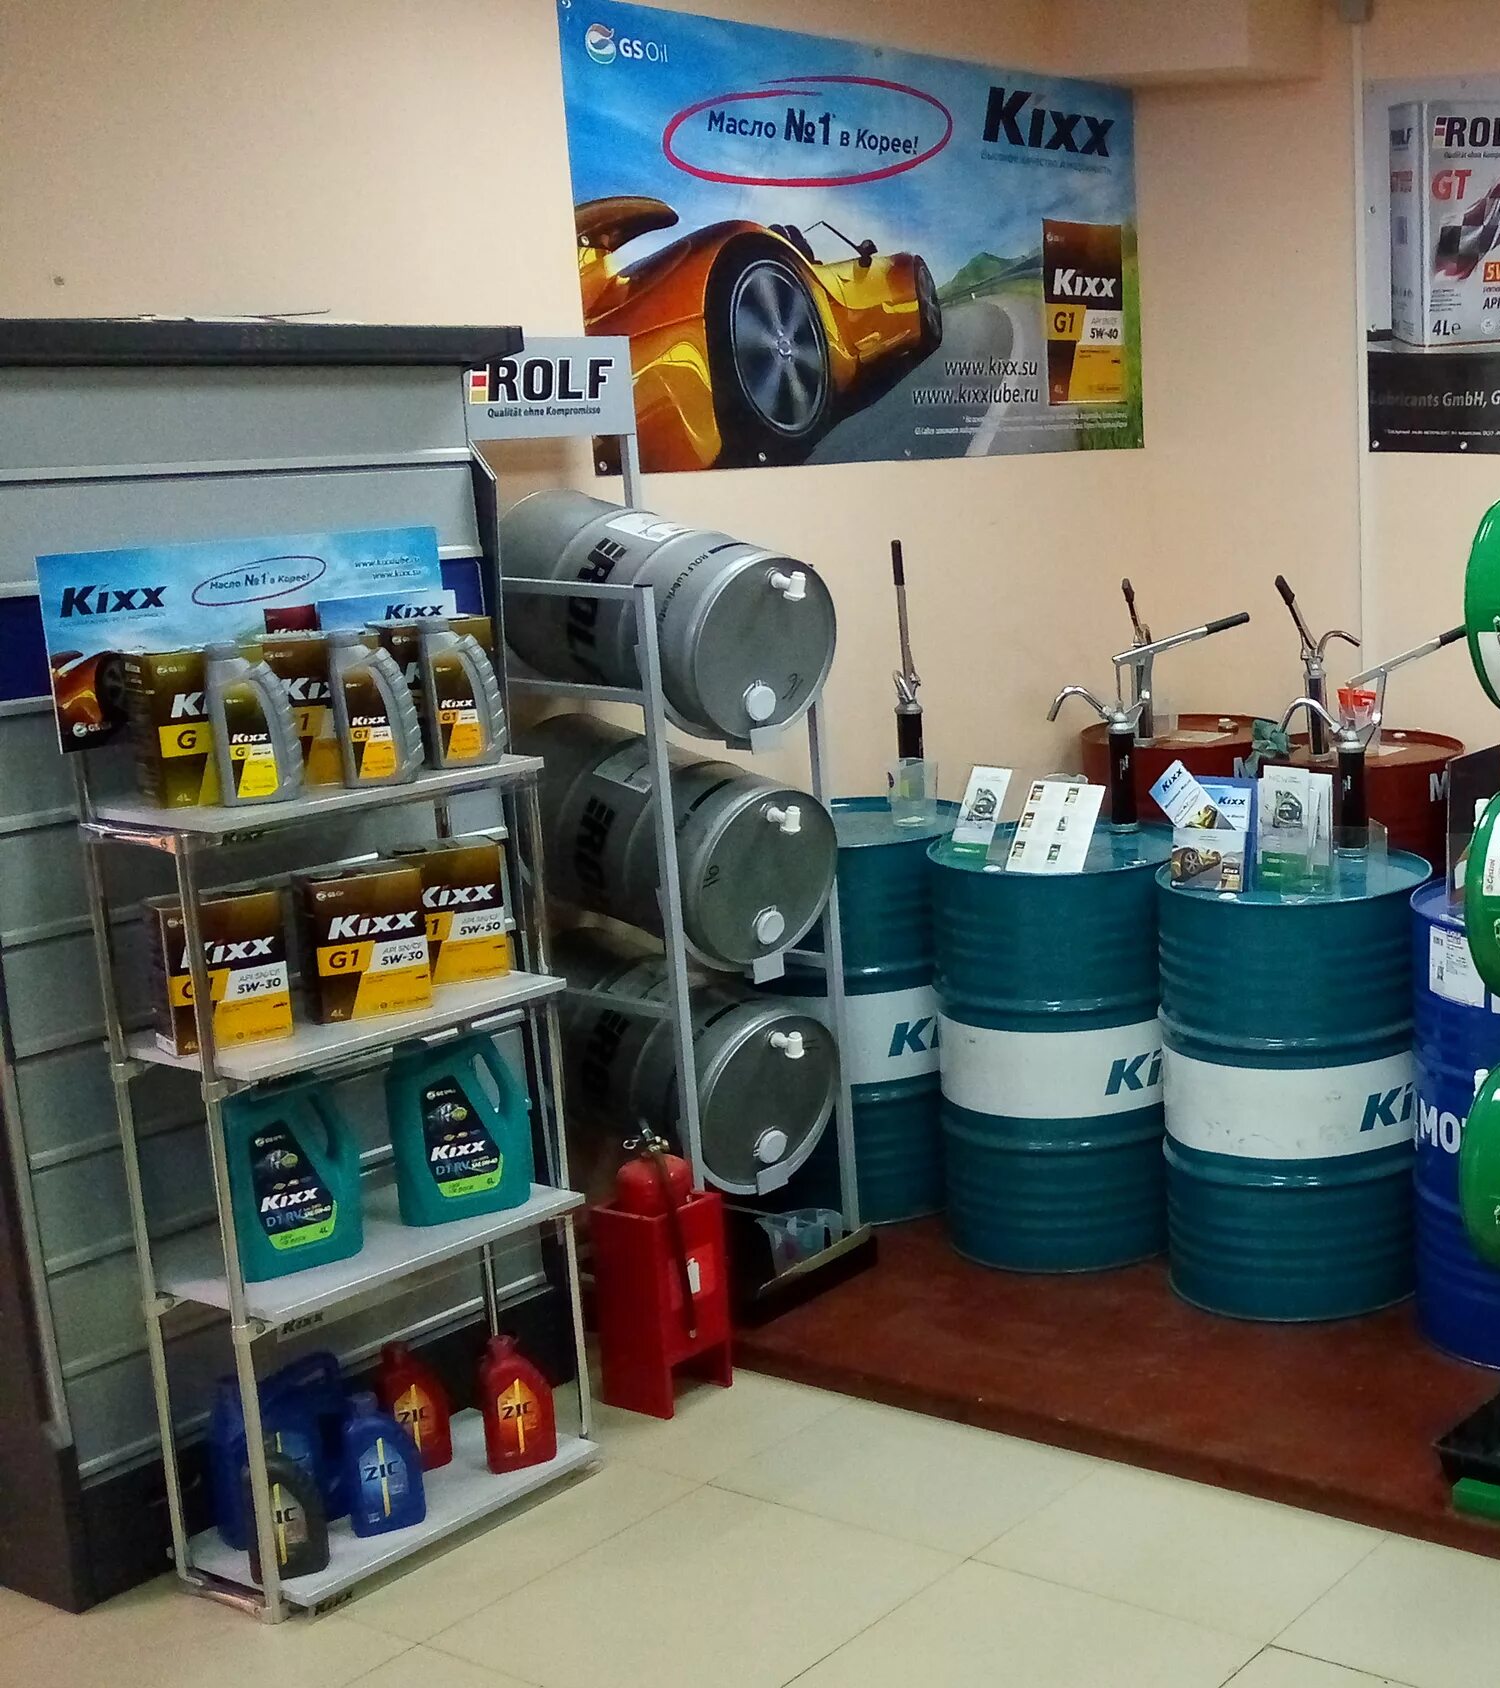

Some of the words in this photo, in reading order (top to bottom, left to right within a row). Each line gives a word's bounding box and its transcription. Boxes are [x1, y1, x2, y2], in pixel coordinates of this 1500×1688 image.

[620, 38, 643, 60] GS
[646, 41, 668, 63] Oil
[983, 86, 1115, 157] Kixx
[708, 110, 777, 139] Масло
[840, 131, 851, 147] в
[856, 129, 919, 155] Корее!
[1431, 169, 1472, 200] GT
[1053, 268, 1117, 298] Kixx
[1482, 296, 1500, 310] API
[1054, 312, 1075, 334] G1
[1090, 327, 1119, 340] 5W-40
[944, 355, 1038, 376] www.kixx.su
[486, 357, 615, 402] ROLF
[912, 383, 1039, 405] www.kixxlube.ru
[1442, 391, 1488, 409] GmbH,
[487, 406, 522, 418] Qualität
[524, 405, 545, 417] ohne
[546, 404, 601, 418] Kompromisse
[209, 580, 241, 590] Масло
[278, 572, 310, 585] Корее!
[60, 583, 167, 618] Kixx
[384, 603, 444, 620] Kixx
[440, 698, 474, 709] Kixx
[351, 714, 387, 727] Kixx
[442, 712, 457, 722] G1
[176, 729, 197, 749] G
[231, 732, 268, 744] Kixx
[353, 729, 369, 739] G1
[235, 747, 246, 757] G
[1161, 768, 1183, 793] Kixx
[1217, 796, 1246, 806] Kixx
[421, 883, 496, 909] Kixx
[327, 910, 418, 941] Kixx
[459, 921, 501, 936] 5W-50
[328, 949, 360, 969] G1
[381, 950, 424, 967] 5W-30
[237, 977, 282, 994] 5W-30
[1105, 1049, 1161, 1096] Ki
[1420, 1097, 1467, 1154] MO
[430, 1140, 486, 1162] Kixx
[260, 1187, 319, 1213] Kixx
[398, 1407, 428, 1424] ZIC
[502, 1401, 532, 1420] ZIC
[363, 1460, 399, 1482] ZIC
[276, 1507, 297, 1524] IC
